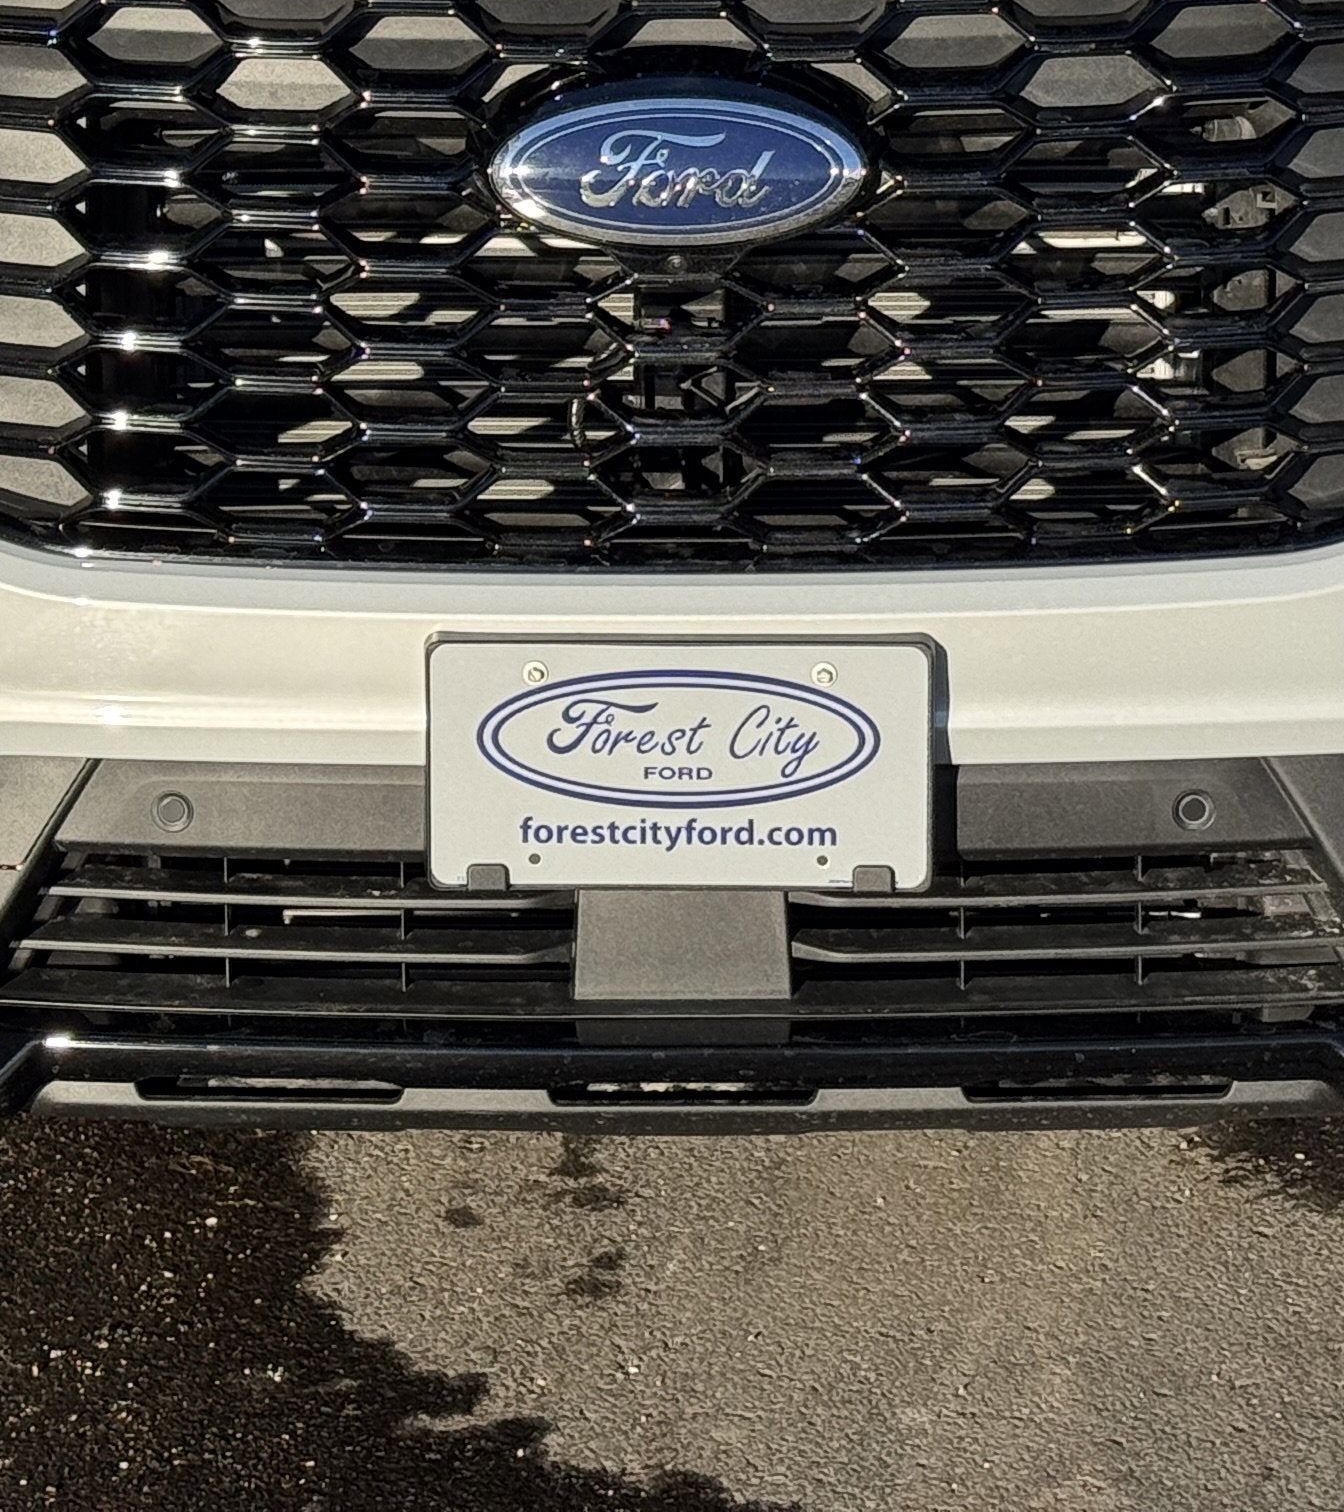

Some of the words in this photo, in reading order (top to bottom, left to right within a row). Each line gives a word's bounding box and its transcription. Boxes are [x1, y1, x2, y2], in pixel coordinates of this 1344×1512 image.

[580, 129, 777, 208] Ford
[546, 698, 713, 757] Forest
[729, 704, 821, 779] City
[643, 766, 713, 781] FORD
[519, 816, 838, 852] forestcityford.com
